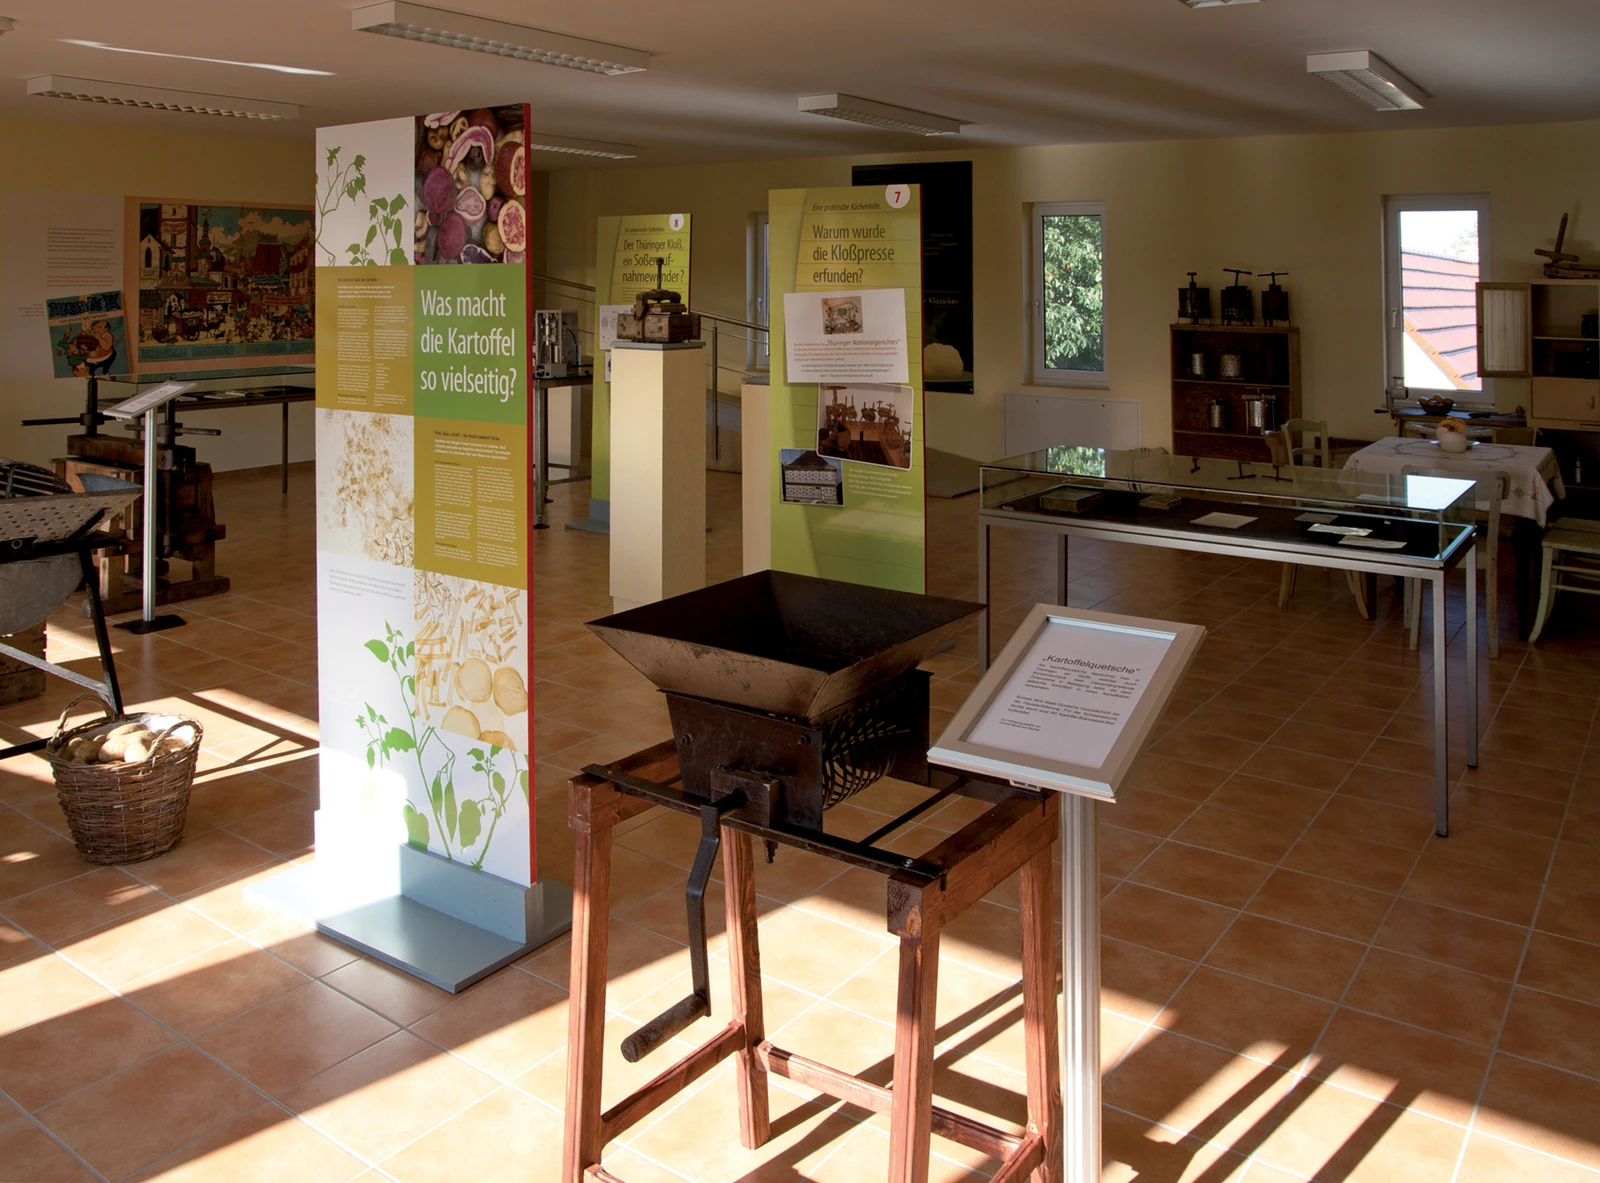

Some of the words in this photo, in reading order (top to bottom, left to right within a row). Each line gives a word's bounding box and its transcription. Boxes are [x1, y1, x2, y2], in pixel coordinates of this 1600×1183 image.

[894, 191, 901, 204] 7
[812, 203, 824, 212] Eine
[824, 202, 850, 213] praktische
[850, 202, 882, 211] Küchenhilfe.
[674, 219, 679, 227] 8
[812, 225, 850, 239] Warum
[852, 224, 886, 239] wurde
[624, 240, 634, 250] Der
[635, 240, 666, 252] Thüringer
[666, 238, 684, 250] Kloß,
[623, 257, 632, 266] ein
[634, 253, 674, 267] Soßenuf-
[812, 246, 828, 261] die
[831, 243, 895, 265] Kloßpresse
[623, 270, 685, 283] nahmewnder?
[812, 268, 864, 283] erfunden?
[420, 289, 452, 317] Was
[456, 288, 506, 317] macht
[928, 297, 958, 305] Klassiker
[420, 326, 443, 354] die
[448, 327, 515, 357] Kartoffel
[420, 370, 437, 391] so
[440, 365, 517, 403] vielseitig?
[1042, 654, 1141, 675] „Kartoffelquetsche“
